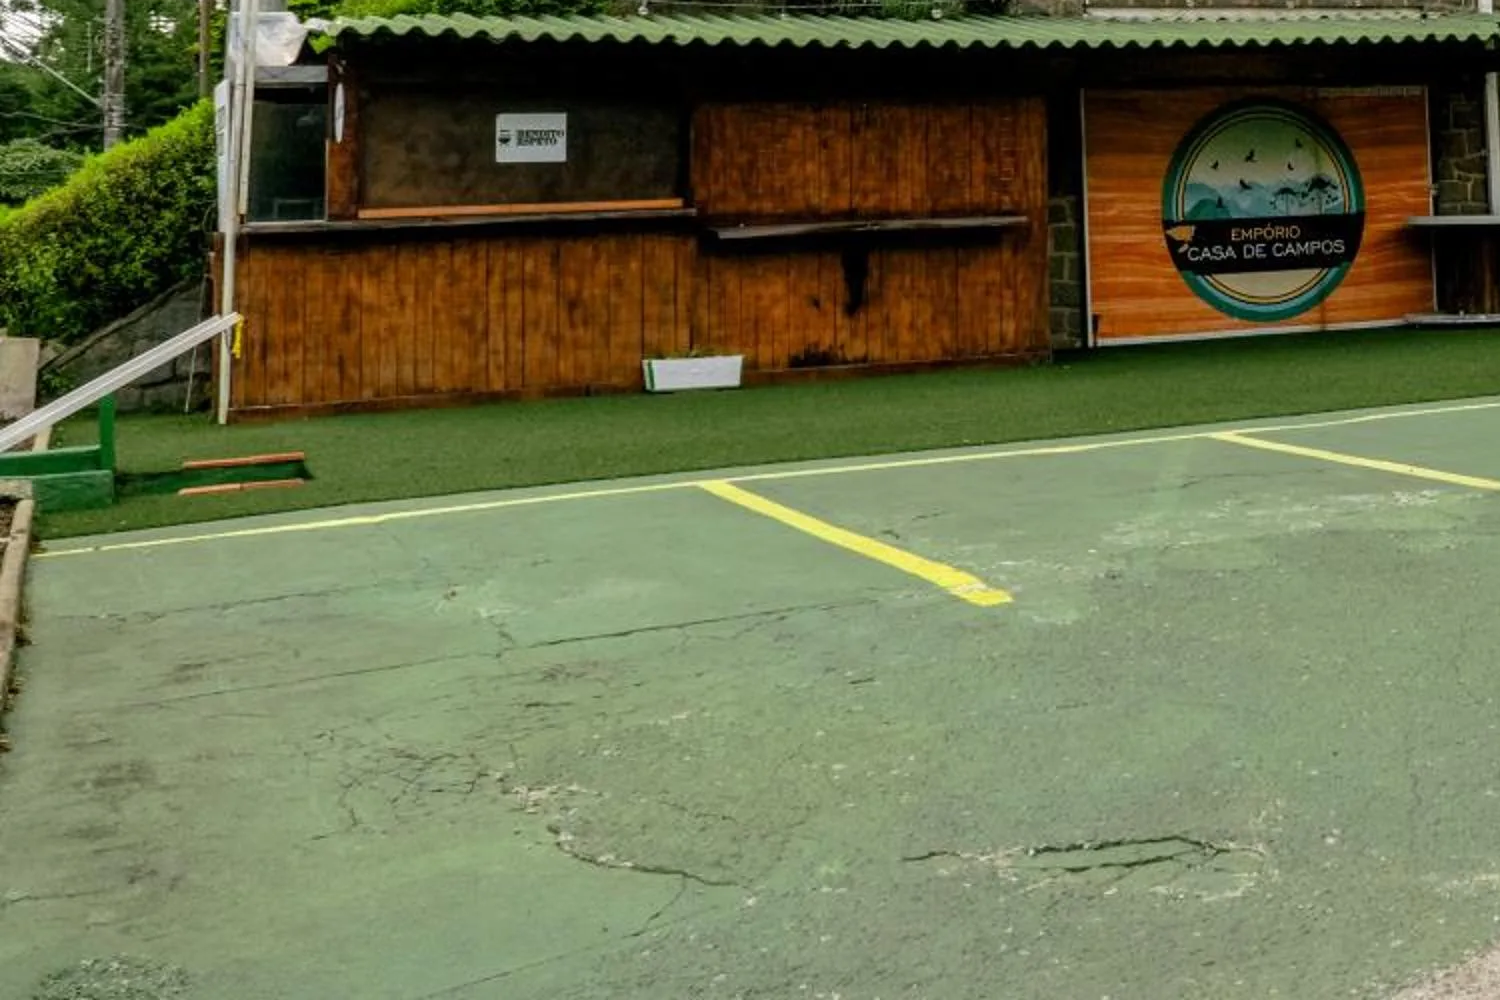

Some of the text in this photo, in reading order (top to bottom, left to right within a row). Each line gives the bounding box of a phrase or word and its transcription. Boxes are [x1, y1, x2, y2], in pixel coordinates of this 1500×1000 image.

[1231, 223, 1301, 242] EMPÓRIO
[1187, 239, 1346, 261] CASA DE CAMPOS
